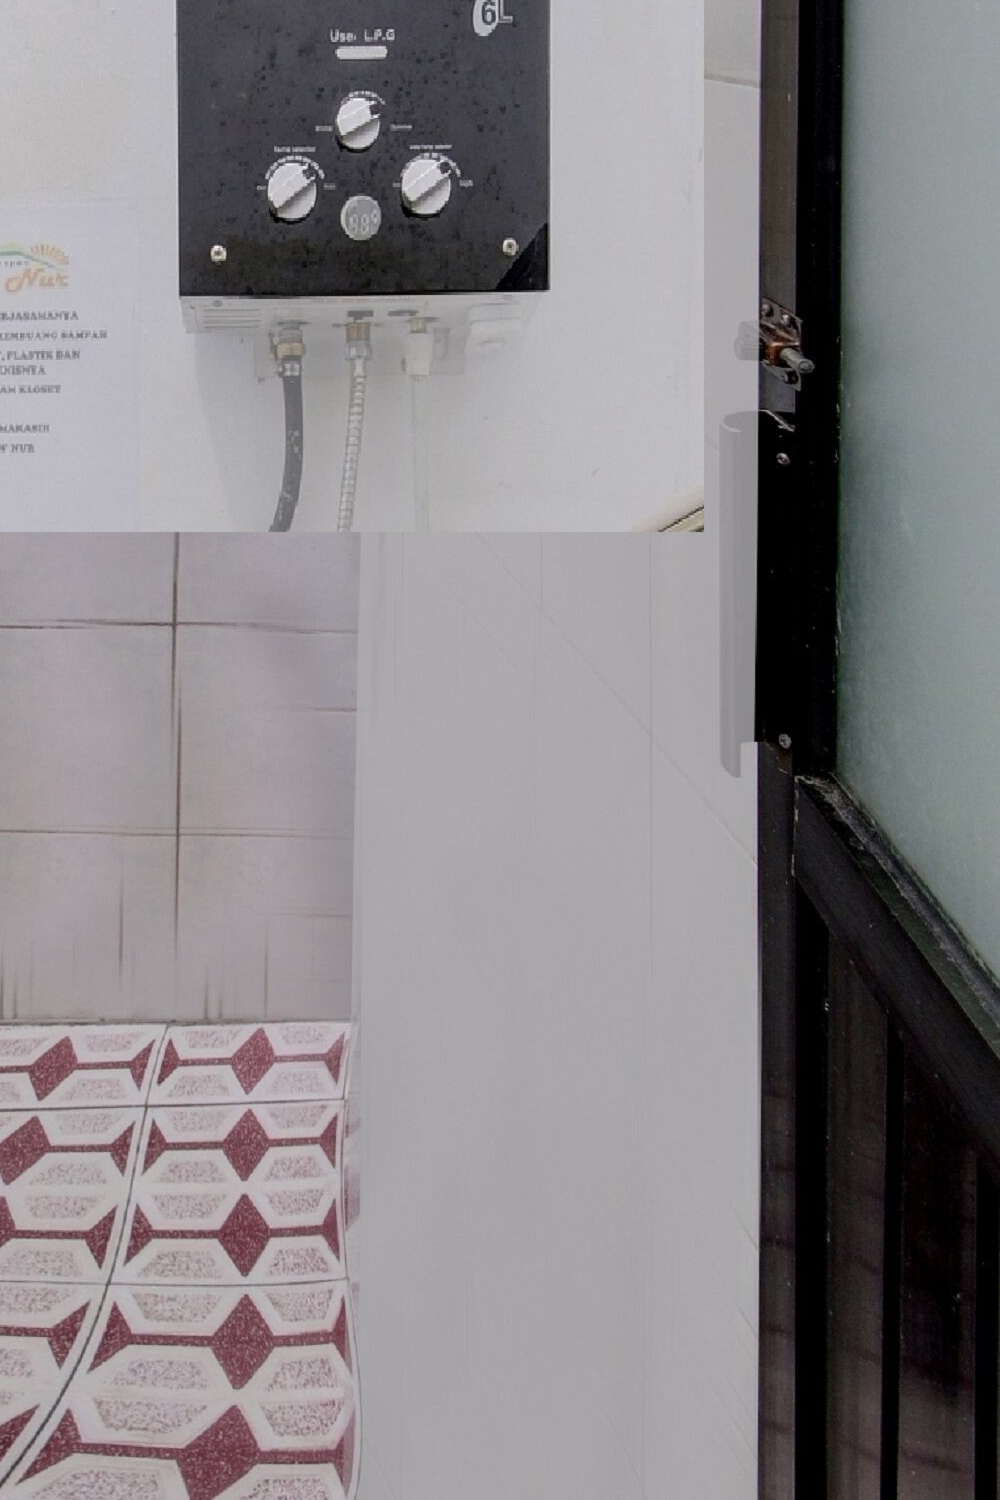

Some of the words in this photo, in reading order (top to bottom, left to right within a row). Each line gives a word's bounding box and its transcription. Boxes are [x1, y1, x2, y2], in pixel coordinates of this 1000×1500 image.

[5, 267, 69, 293] Nur
[60, 330, 107, 339] SAMPAH
[7, 351, 53, 360] PLASTIK
[56, 350, 80, 360] DAN
[19, 385, 61, 394] KLOSET
[10, 444, 35, 453] NUR
